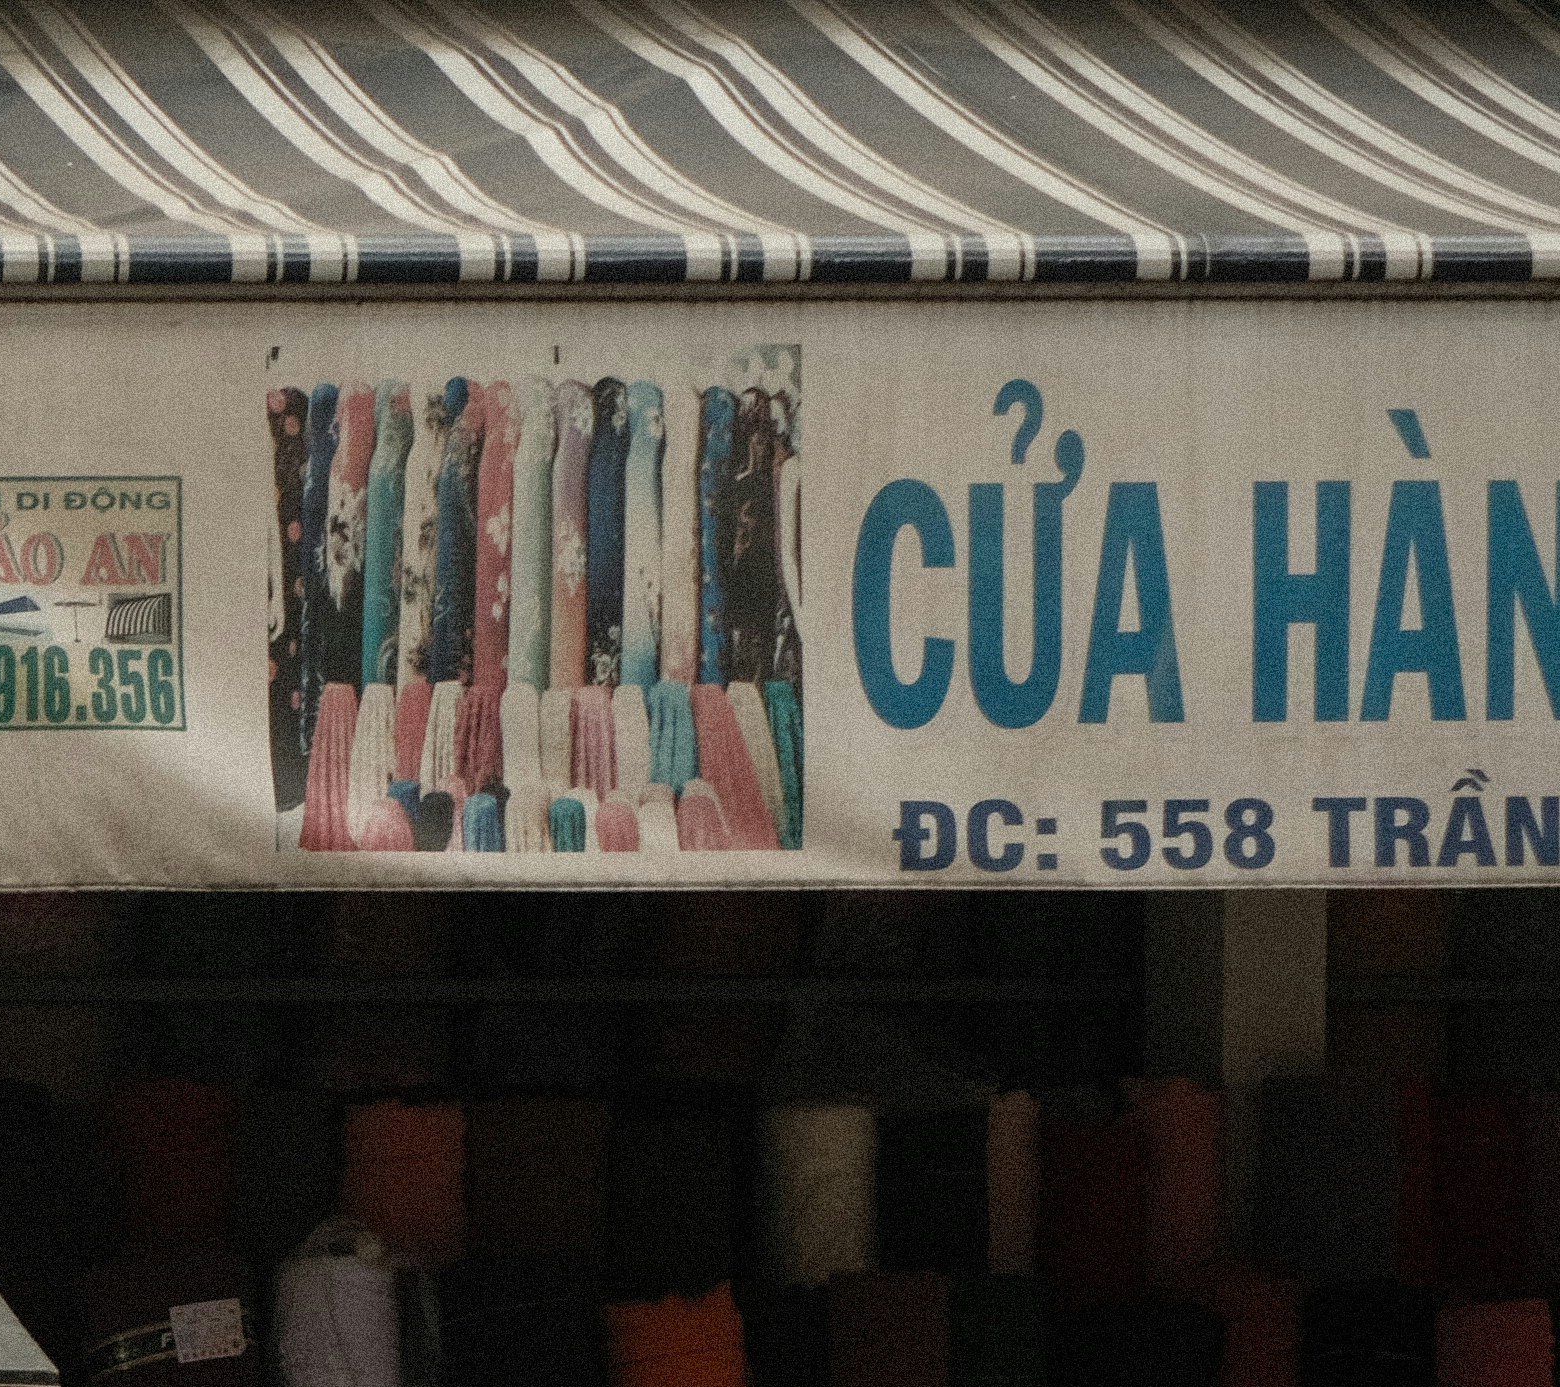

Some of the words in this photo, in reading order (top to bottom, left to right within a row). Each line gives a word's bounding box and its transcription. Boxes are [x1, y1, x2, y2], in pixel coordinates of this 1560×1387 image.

[16, 490, 50, 511] DI
[63, 486, 171, 514] ĐỘNG
[79, 531, 171, 586] AN
[852, 378, 1186, 730] CỬA
[892, 799, 1059, 873] ĐC:
[1098, 797, 1277, 872] 558
[1312, 768, 1560, 868] TRẦN
